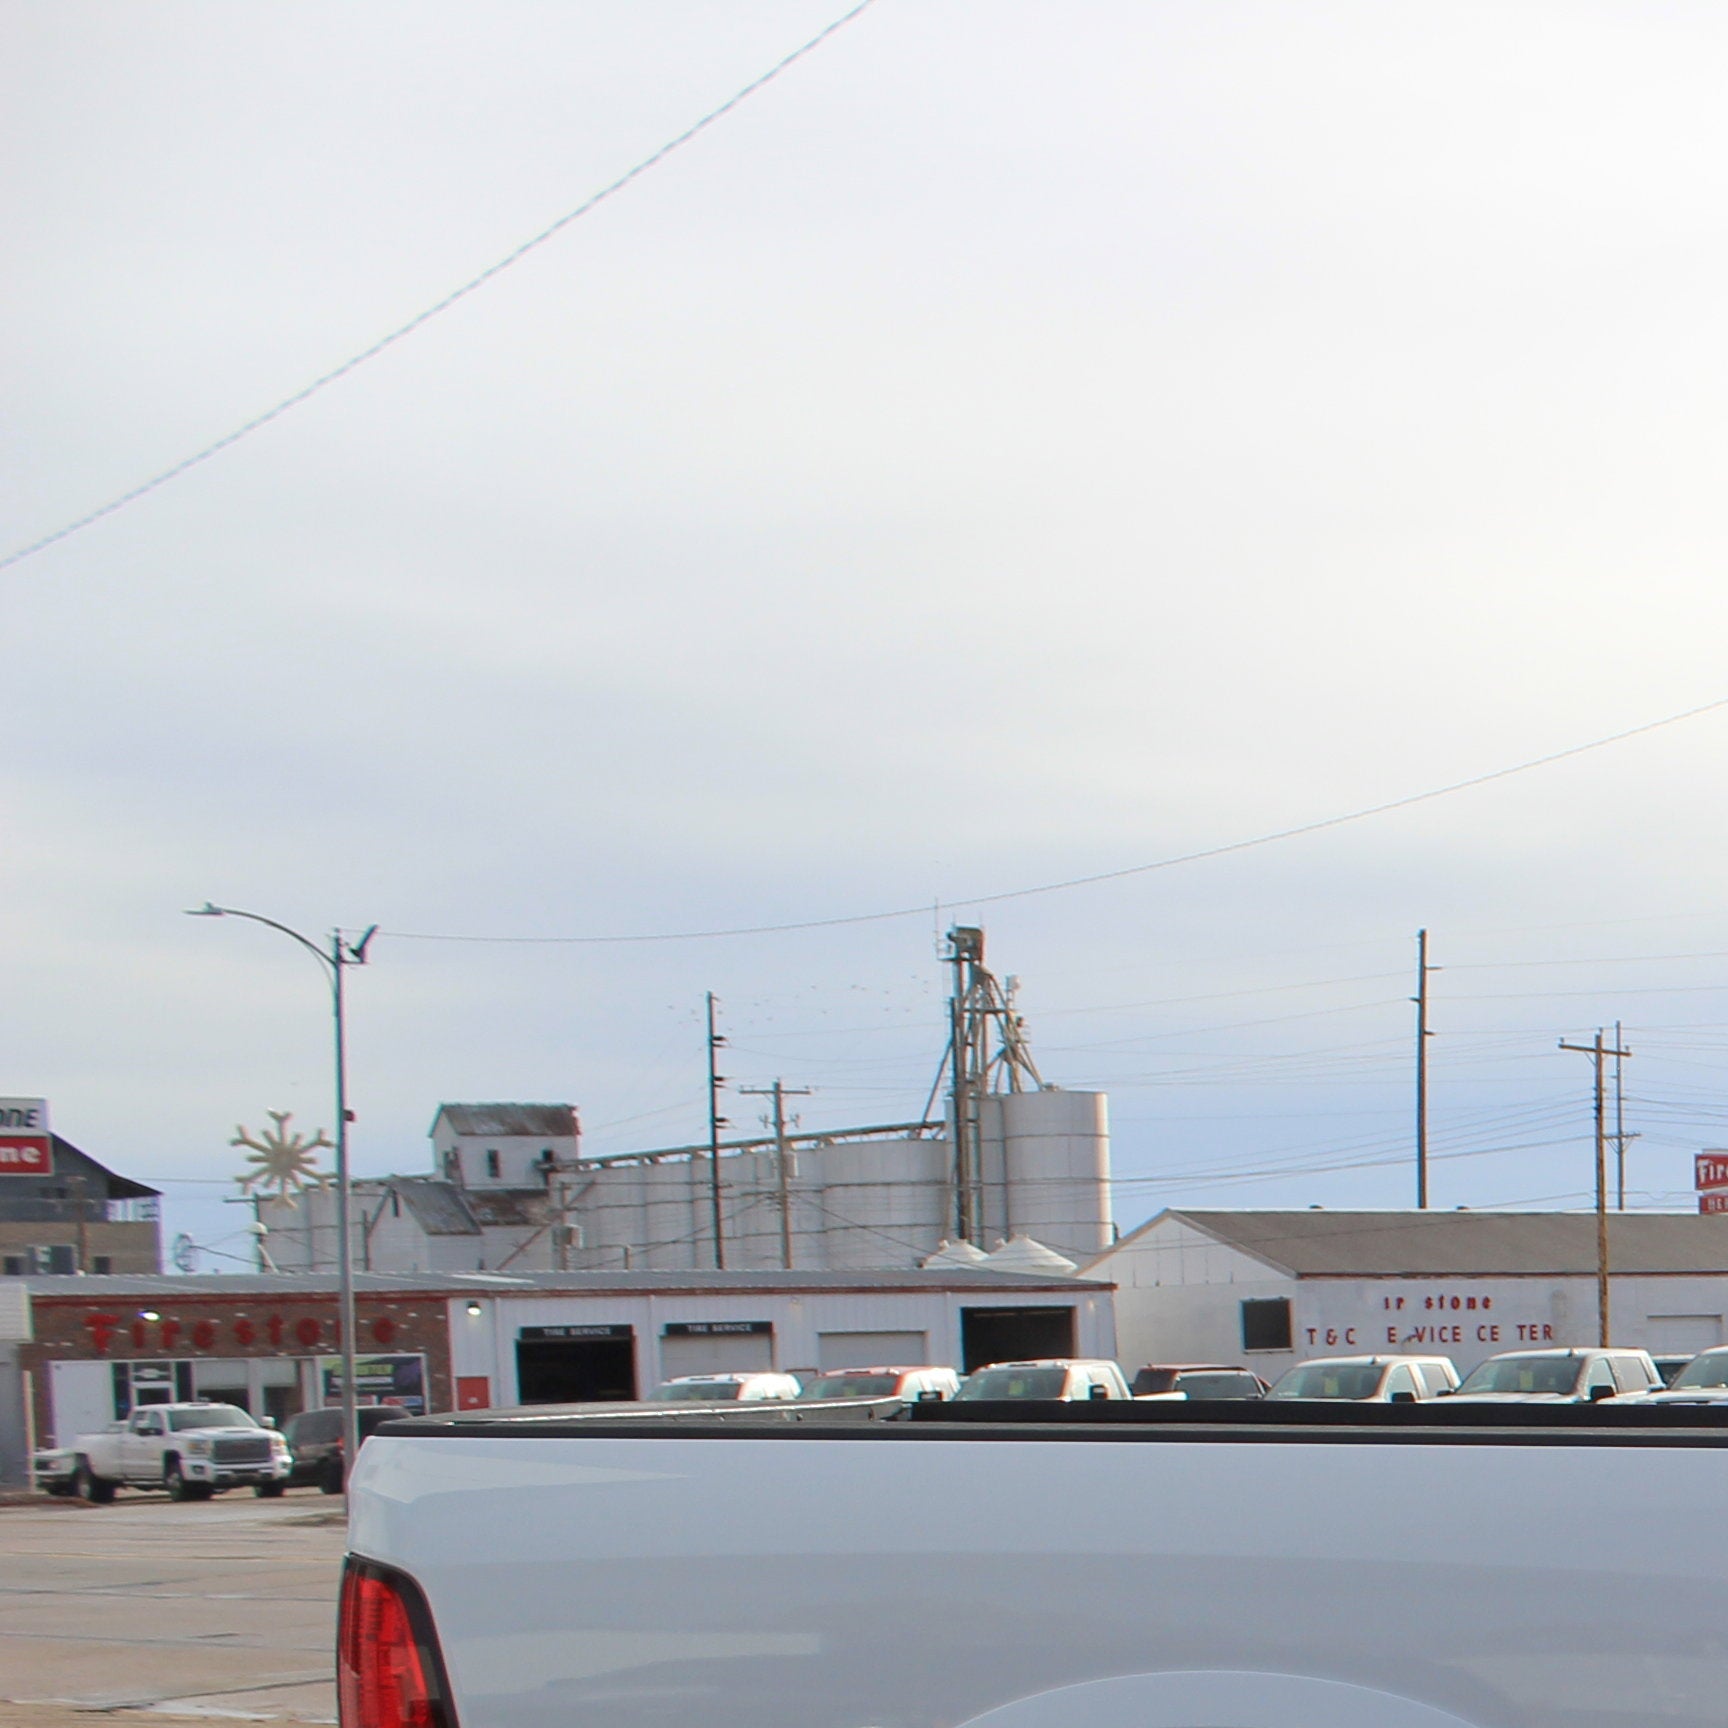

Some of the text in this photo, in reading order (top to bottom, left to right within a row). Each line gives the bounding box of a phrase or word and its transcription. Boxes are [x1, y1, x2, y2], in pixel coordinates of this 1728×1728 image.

[569, 1326, 611, 1336] SERVICE
[1306, 1328, 1318, 1346] T
[1345, 1328, 1356, 1345] C
